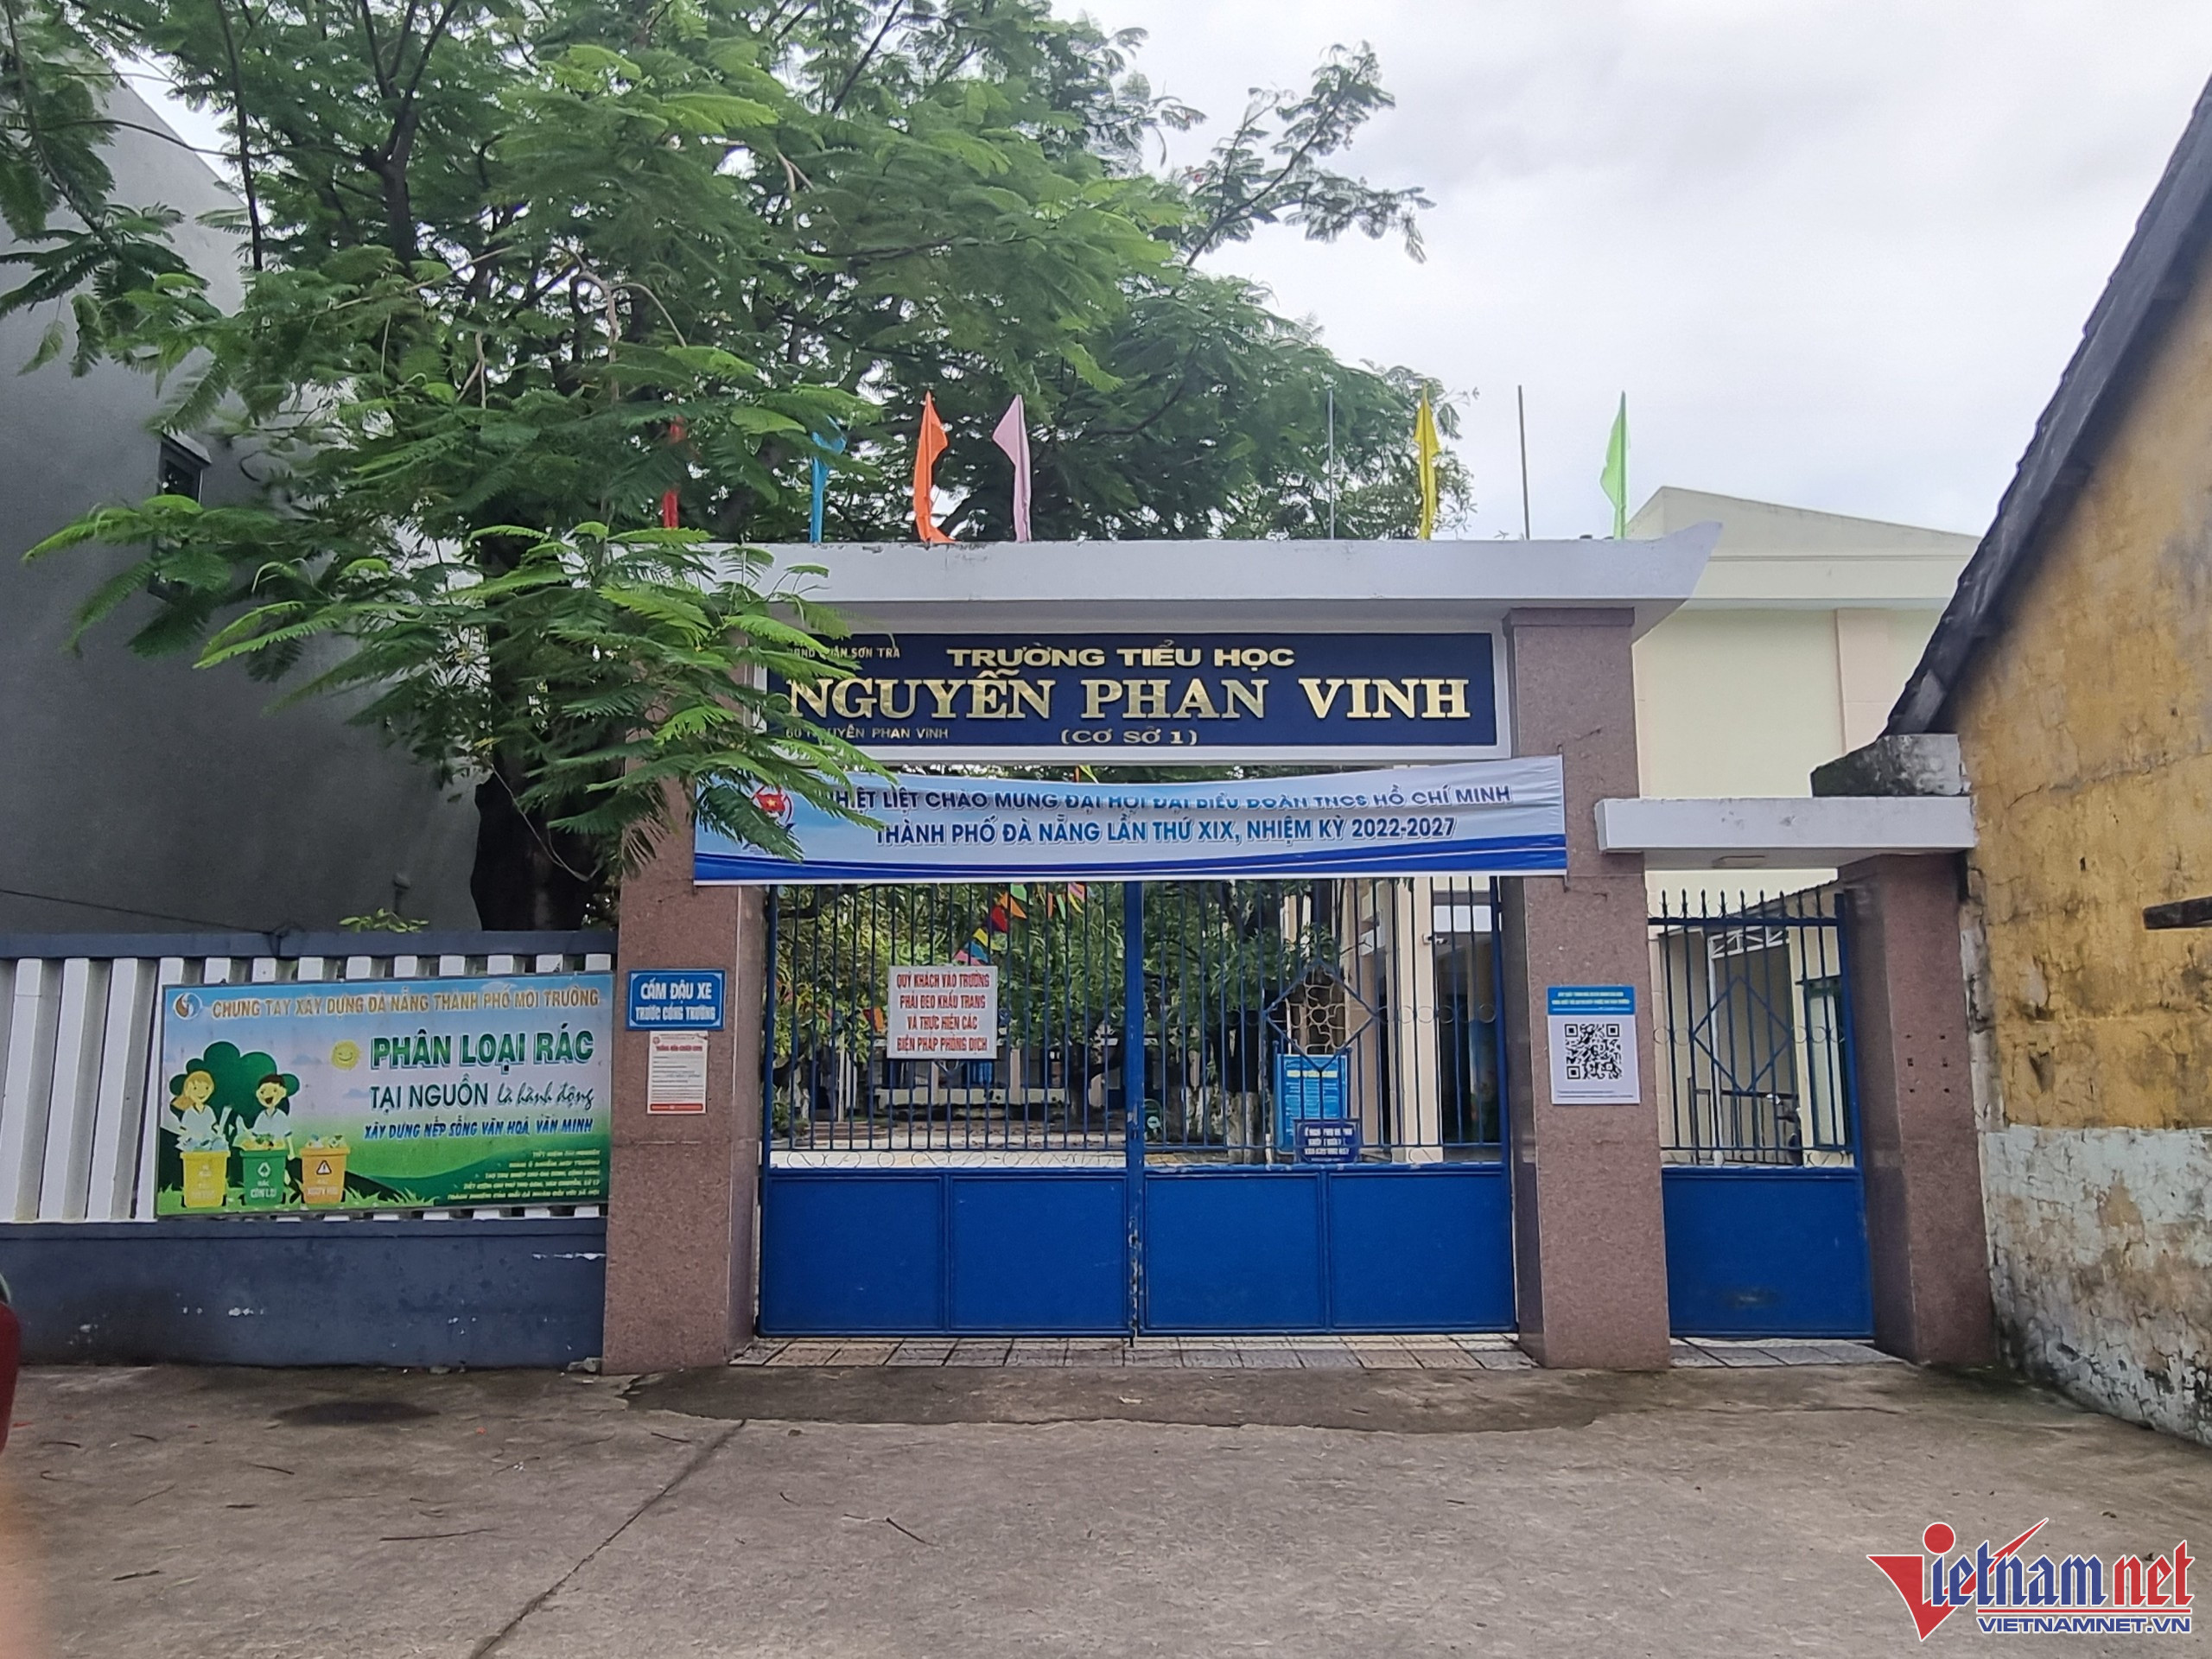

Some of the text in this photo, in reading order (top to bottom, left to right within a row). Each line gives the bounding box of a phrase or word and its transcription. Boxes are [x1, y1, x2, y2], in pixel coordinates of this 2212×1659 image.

[946, 639, 1294, 671] TRƯỜNG TIỂU HỌC
[785, 668, 1471, 720] NGUYỄN PHAN VINH
[871, 728, 911, 741] PHAN
[1122, 725, 1162, 745] SỞ
[824, 786, 876, 814] HỆT
[883, 786, 918, 813] LIỆT
[925, 788, 988, 809] CHÀO
[1373, 785, 1405, 805] HỒ
[1412, 785, 1451, 805] CHÍ
[1456, 785, 1511, 804] MINH
[952, 815, 996, 842] PHỐ
[1002, 817, 1032, 842] ĐÀ
[1039, 814, 1100, 842] NẴNG
[1108, 814, 1146, 842] LẦN
[1153, 817, 1194, 842] THỨ
[1198, 820, 1242, 844] XIX,
[1247, 816, 1313, 844] NHIỆM
[1319, 816, 1346, 838] KỲ
[1352, 817, 1455, 838] 2022-2027
[212, 999, 260, 1019] CHUNG
[265, 998, 292, 1017] TAY
[296, 995, 322, 1015] XÂY
[368, 992, 386, 1014] ĐÀ
[483, 984, 511, 1009] PHỐ
[544, 985, 600, 1007] TRƯỜNG
[640, 976, 712, 1004] CẤM ĐẬU XE
[370, 1023, 594, 1075] PHÂN LOẠI RÁC
[370, 1084, 402, 1113] TẠI
[410, 1073, 489, 1109] NGUỒN
[365, 1121, 386, 1140] XÂY
[562, 1118, 594, 1134] MINH
